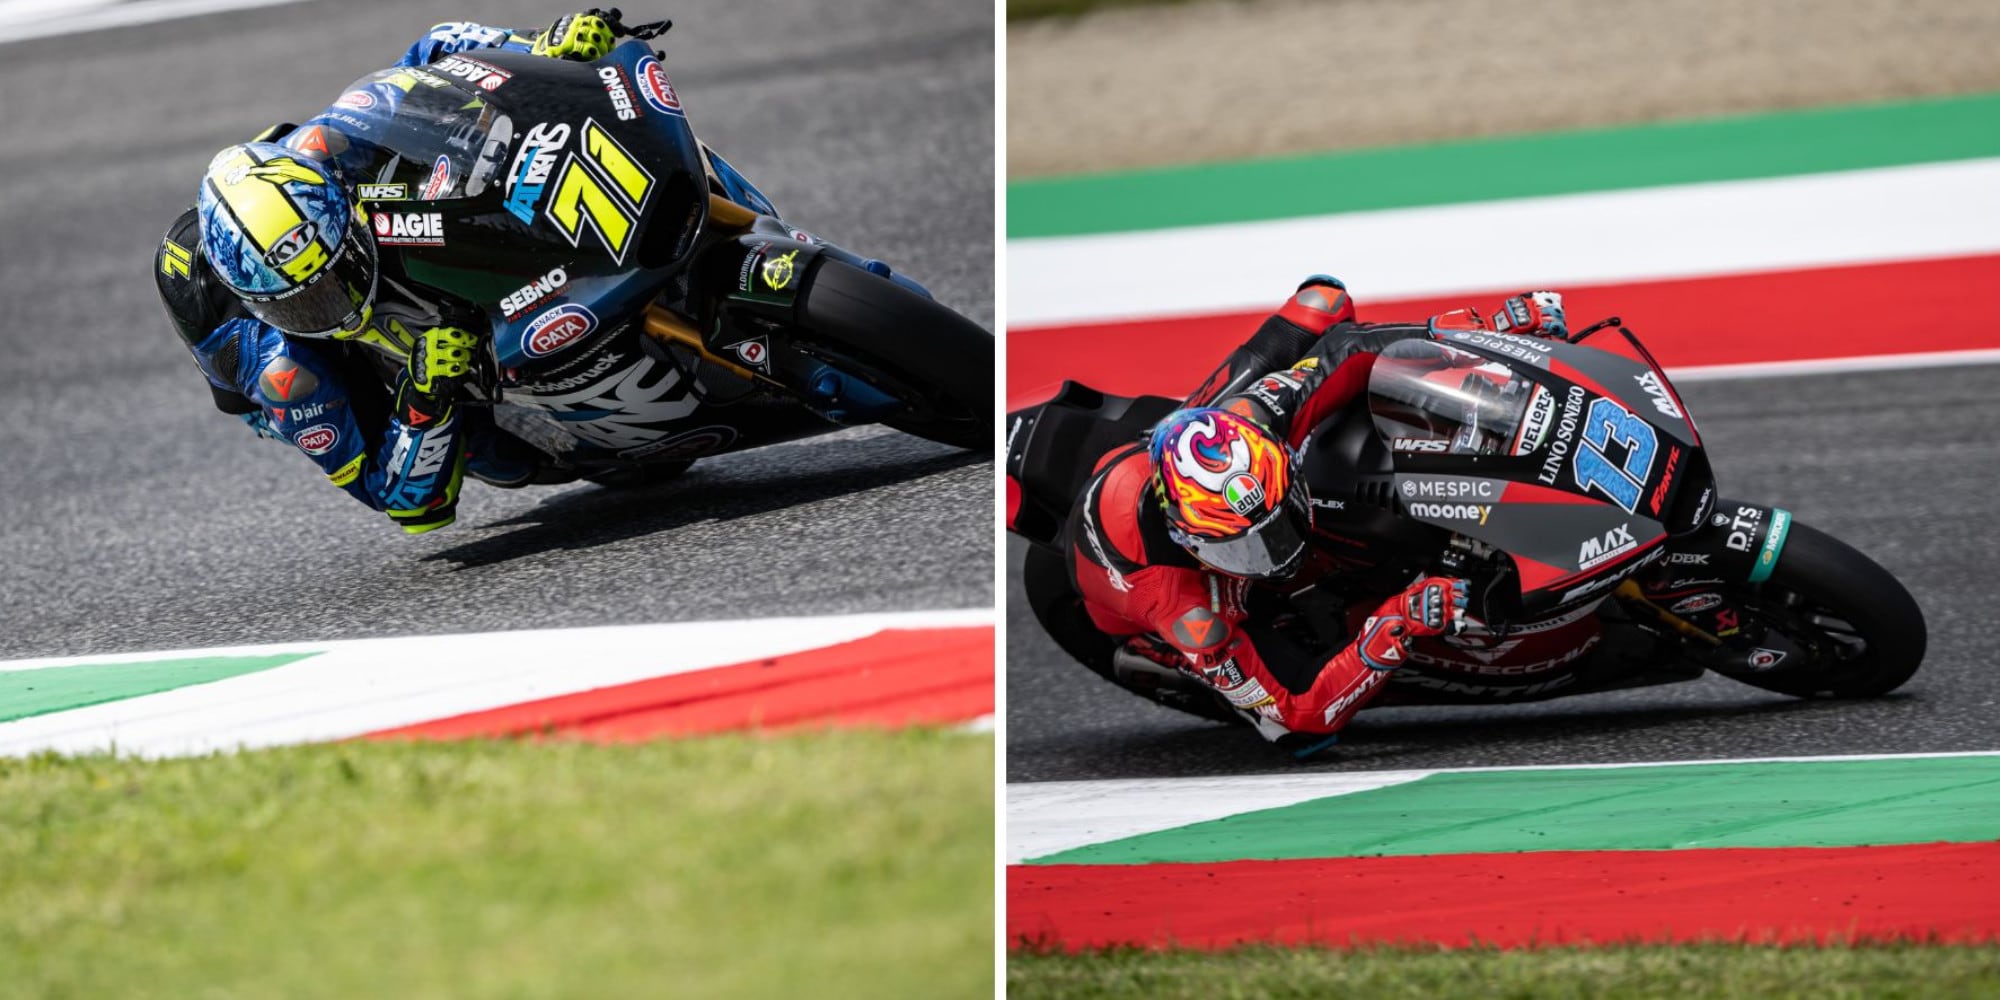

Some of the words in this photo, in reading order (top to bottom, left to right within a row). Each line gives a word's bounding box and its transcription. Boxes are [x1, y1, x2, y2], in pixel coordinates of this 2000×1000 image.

[361, 185, 404, 198] WRS
[545, 116, 656, 267] 71
[391, 213, 444, 236] AGIE
[274, 224, 310, 260] KYT
[162, 238, 192, 280] 71
[534, 308, 562, 329] SNACK
[537, 319, 582, 350] PATA
[1471, 334, 1540, 362] MESPIC
[1634, 371, 1683, 419] MAX
[302, 432, 330, 448] PATA
[1394, 439, 1450, 452] WRS
[1539, 440, 1567, 485] LINO
[1556, 385, 1585, 440] SONEGO
[1573, 397, 1659, 514] 13
[1420, 481, 1492, 497] MESPIC
[1650, 445, 1680, 515] FANTIC
[1237, 490, 1261, 513] agv
[1310, 498, 1345, 510] ALEX
[1410, 503, 1492, 525] mooney
[1578, 523, 1634, 563] MAX
[1726, 506, 1759, 551] DTS
[1409, 635, 1601, 675] OTTECCHIA
